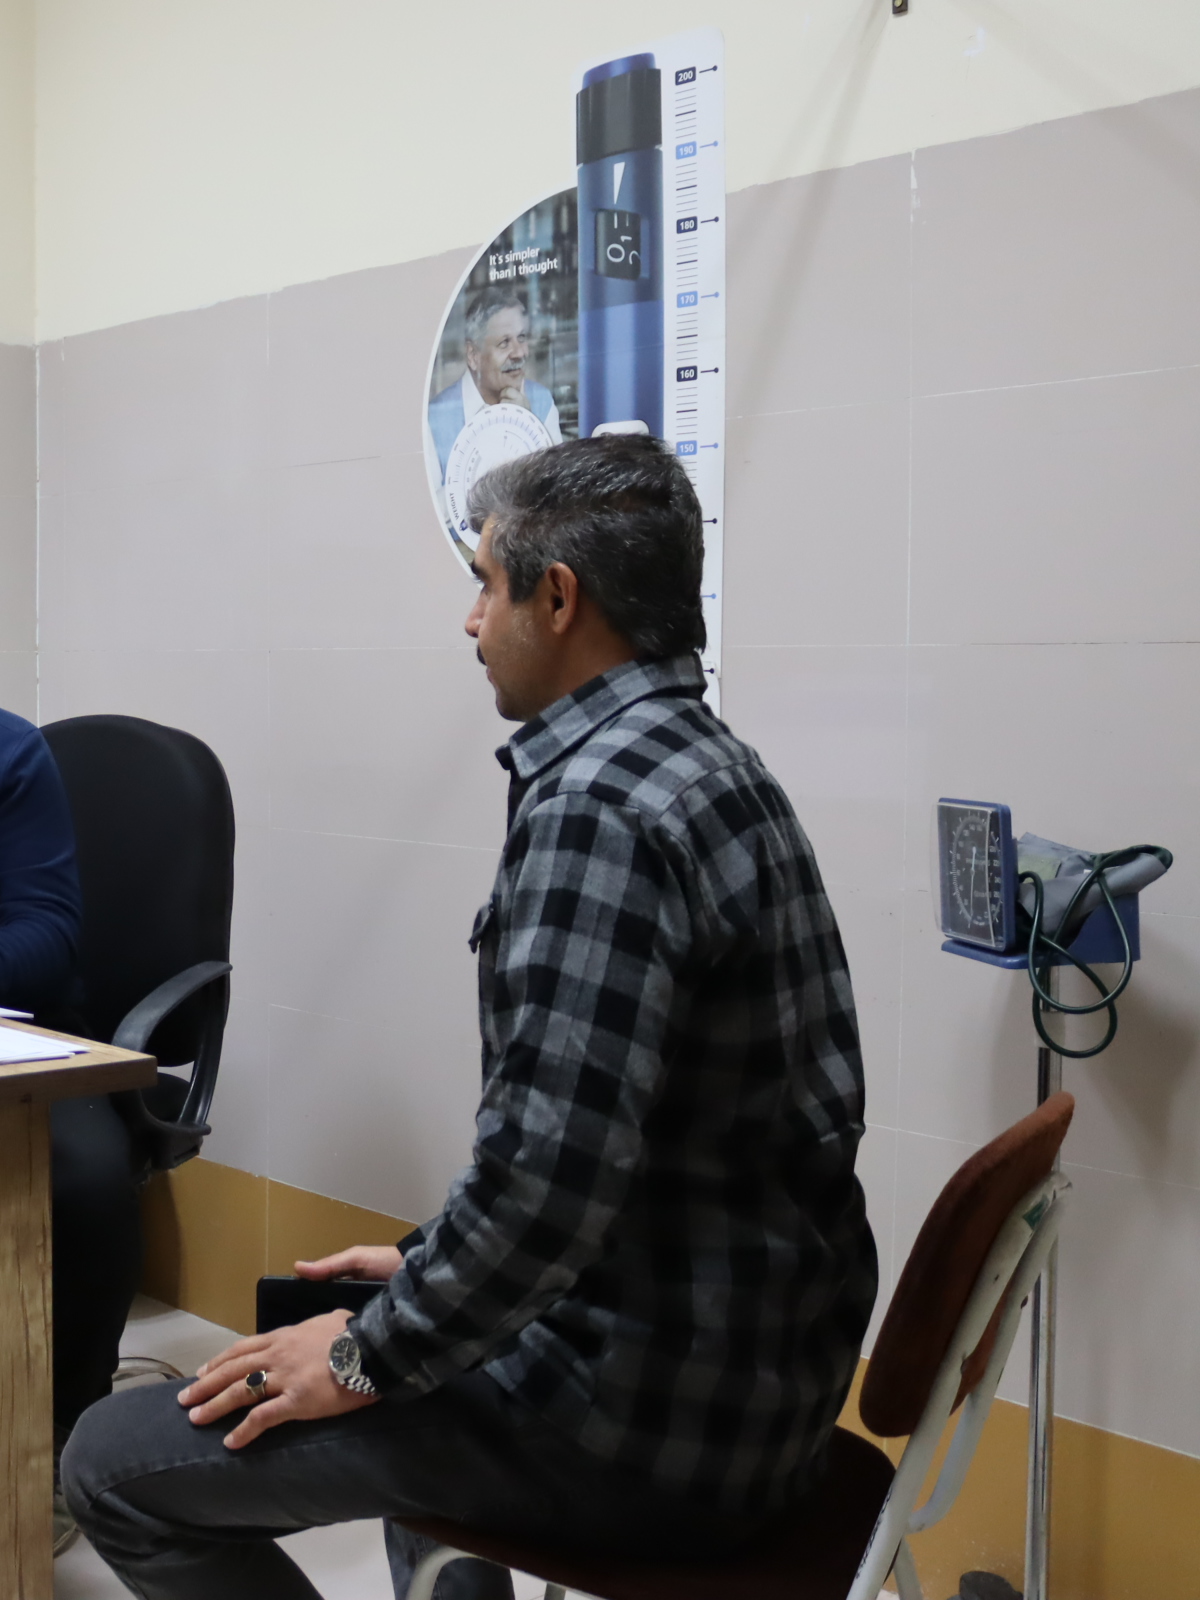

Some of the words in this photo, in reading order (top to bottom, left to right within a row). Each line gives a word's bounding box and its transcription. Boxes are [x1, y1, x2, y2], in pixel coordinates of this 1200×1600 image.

[678, 70, 693, 82] 200
[679, 145, 694, 156] 190
[680, 219, 695, 231] 180
[505, 246, 540, 263] simpler
[489, 268, 511, 281] than
[513, 265, 517, 276] I
[518, 258, 558, 275] thought
[680, 294, 695, 305] 170
[680, 369, 695, 379] 160
[680, 443, 695, 453] 150
[449, 492, 460, 520] WEIGHT
